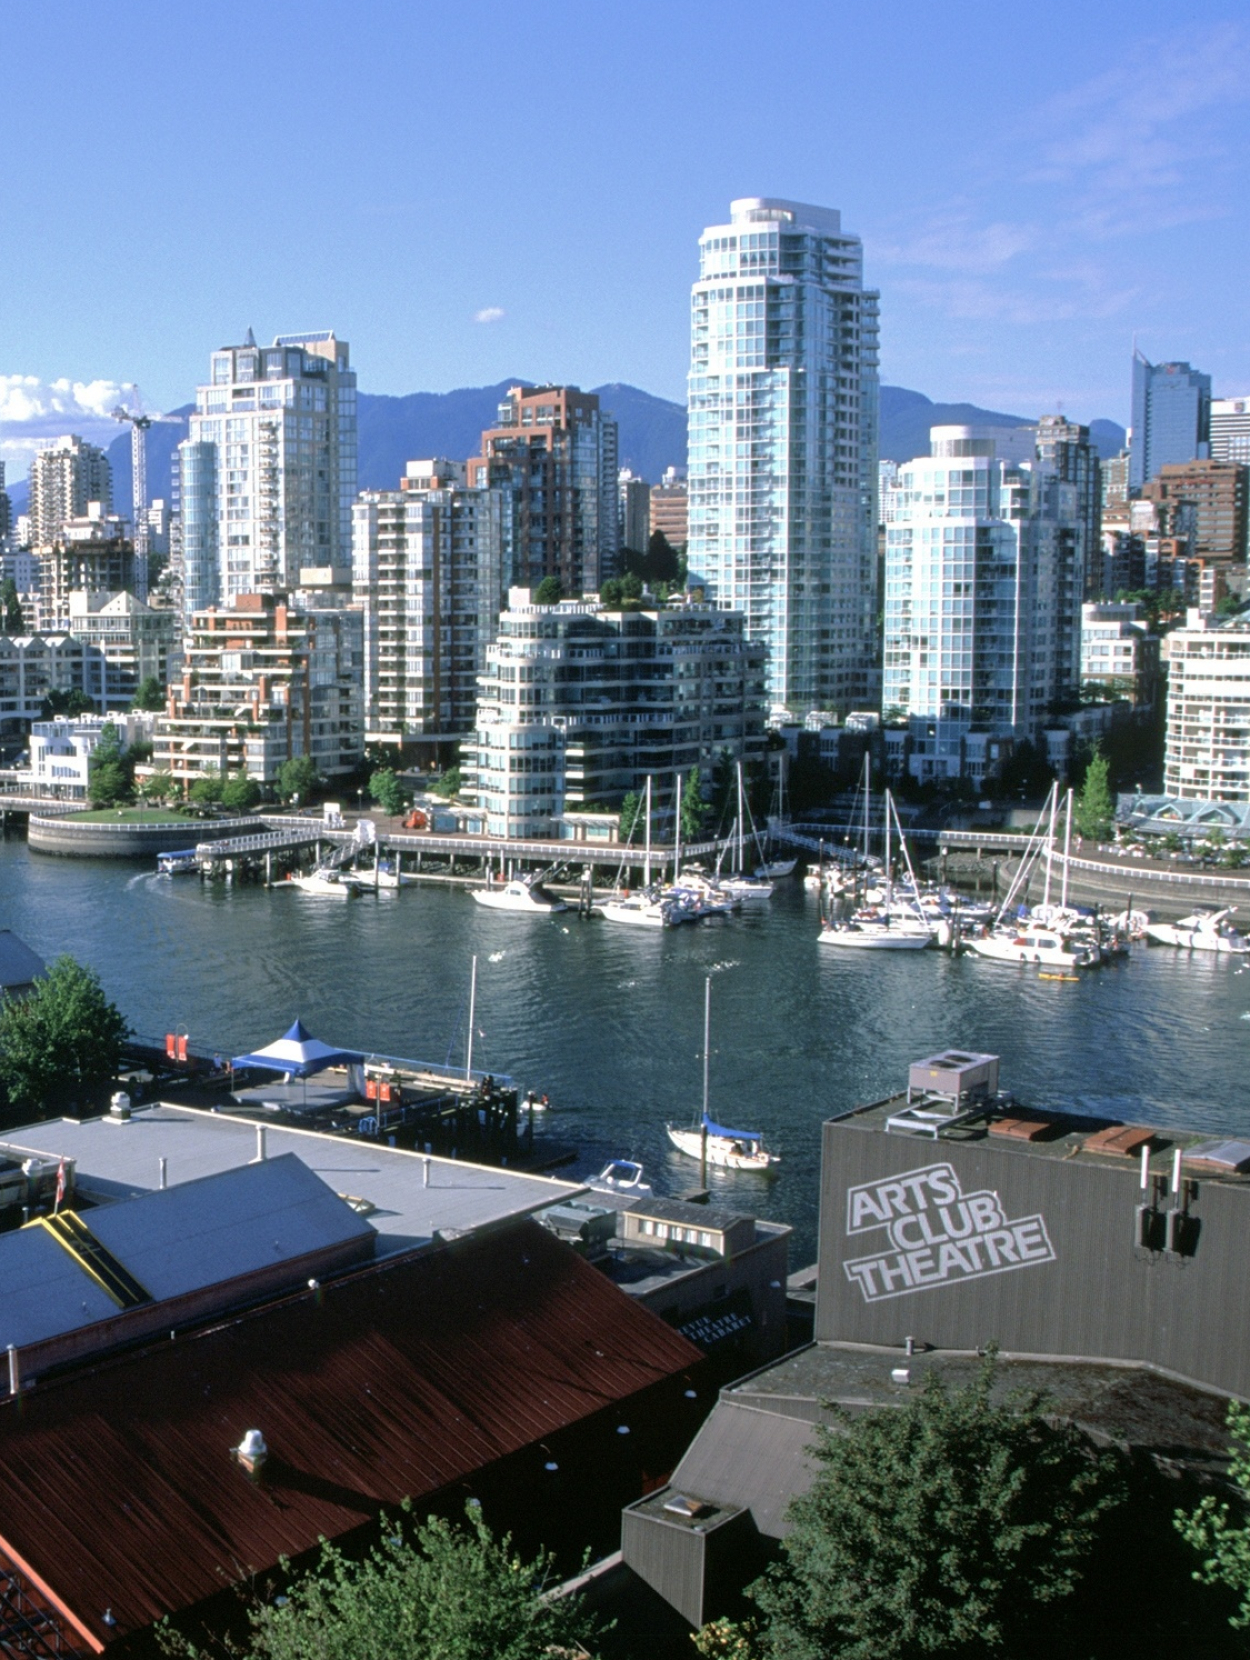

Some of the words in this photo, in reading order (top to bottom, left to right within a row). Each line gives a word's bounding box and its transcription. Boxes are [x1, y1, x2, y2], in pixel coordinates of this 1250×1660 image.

[852, 1169, 956, 1228] ARTS
[892, 1196, 1001, 1250] CLUB
[850, 1221, 1048, 1296] THEATRE
[690, 1312, 738, 1340] THEATRE
